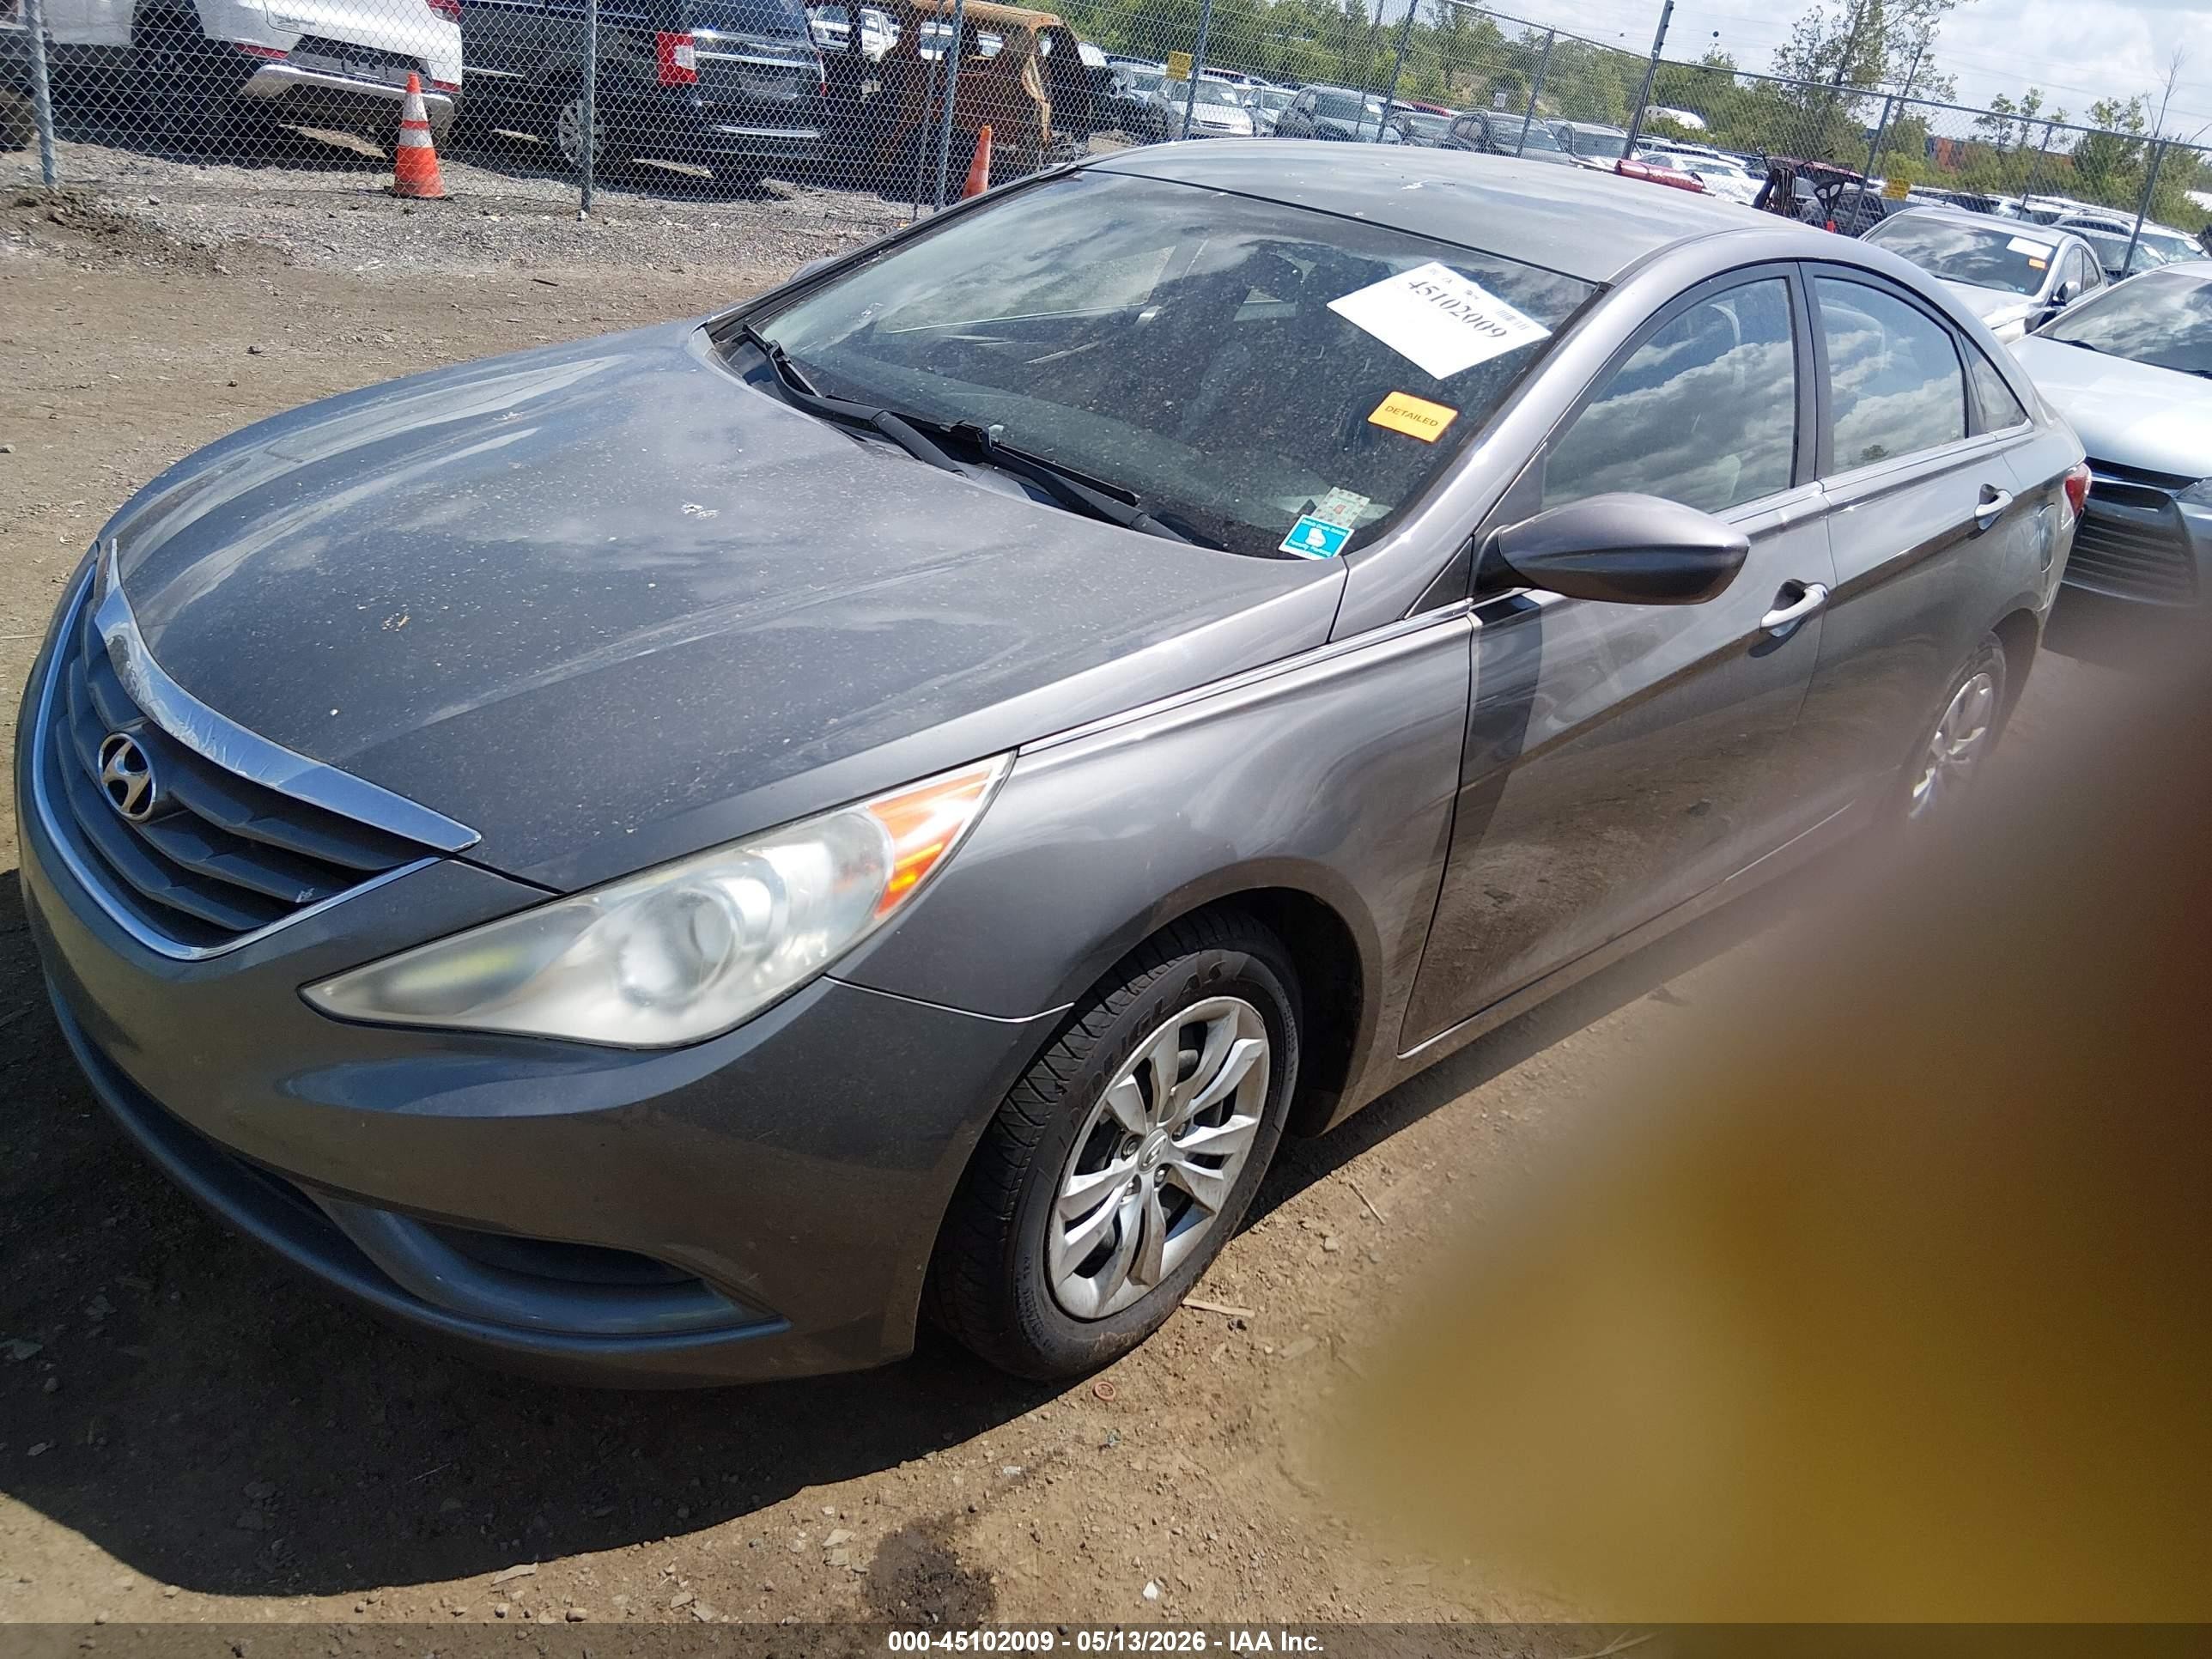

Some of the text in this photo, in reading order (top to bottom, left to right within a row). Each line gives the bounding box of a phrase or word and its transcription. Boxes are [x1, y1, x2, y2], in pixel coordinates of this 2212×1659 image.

[1408, 281, 1507, 337] 45102009
[1384, 405, 1438, 427] DETAILED
[1069, 959, 1228, 1129] DOUGLAS
